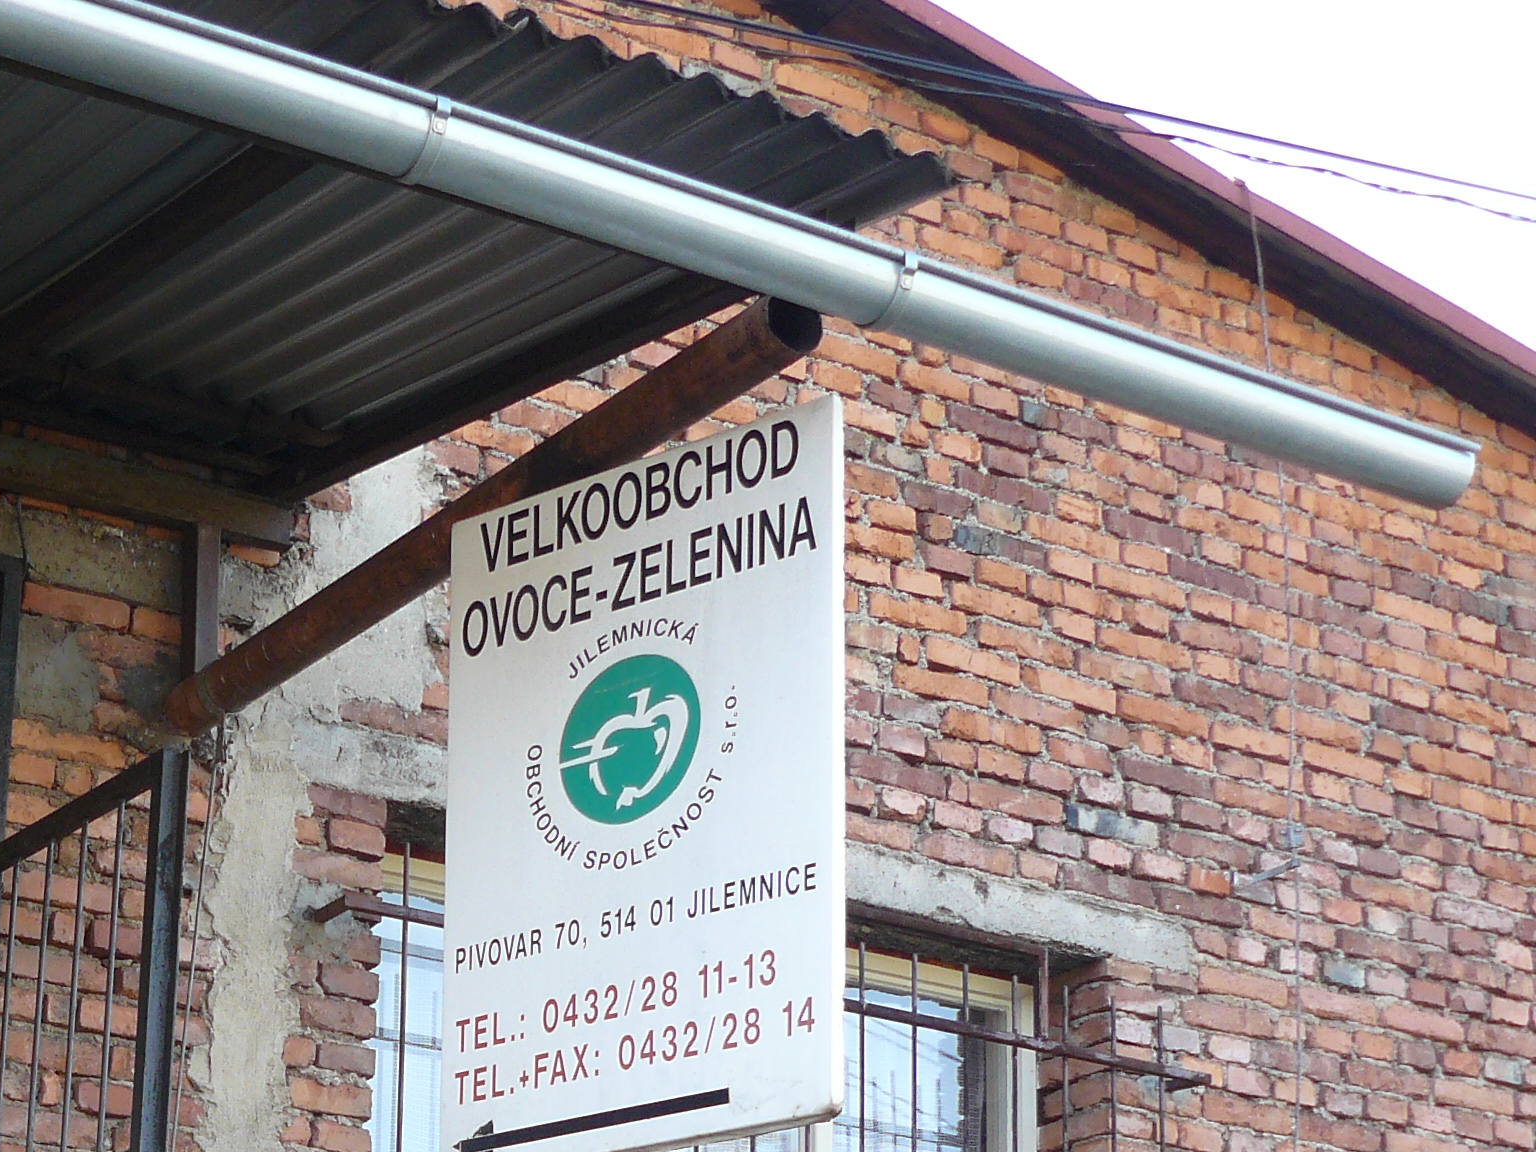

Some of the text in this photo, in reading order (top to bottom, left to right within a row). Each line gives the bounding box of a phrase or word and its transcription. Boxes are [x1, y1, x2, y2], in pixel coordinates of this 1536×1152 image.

[480, 420, 799, 573] VELKOOBCHOD
[462, 497, 817, 657] OVOCE-ZELENINA
[568, 618, 700, 679] JILEMNICKÁ
[526, 744, 581, 861] OBCHODNÍ
[583, 767, 723, 871] SPOLEČNOST
[454, 862, 818, 974] PIVOVAR 70, 514 01 JILEMNICE
[454, 996, 816, 1106] TEL.+FAX: 0432/28 14
[455, 949, 778, 1054] TEL.: 0432/28 11-13
